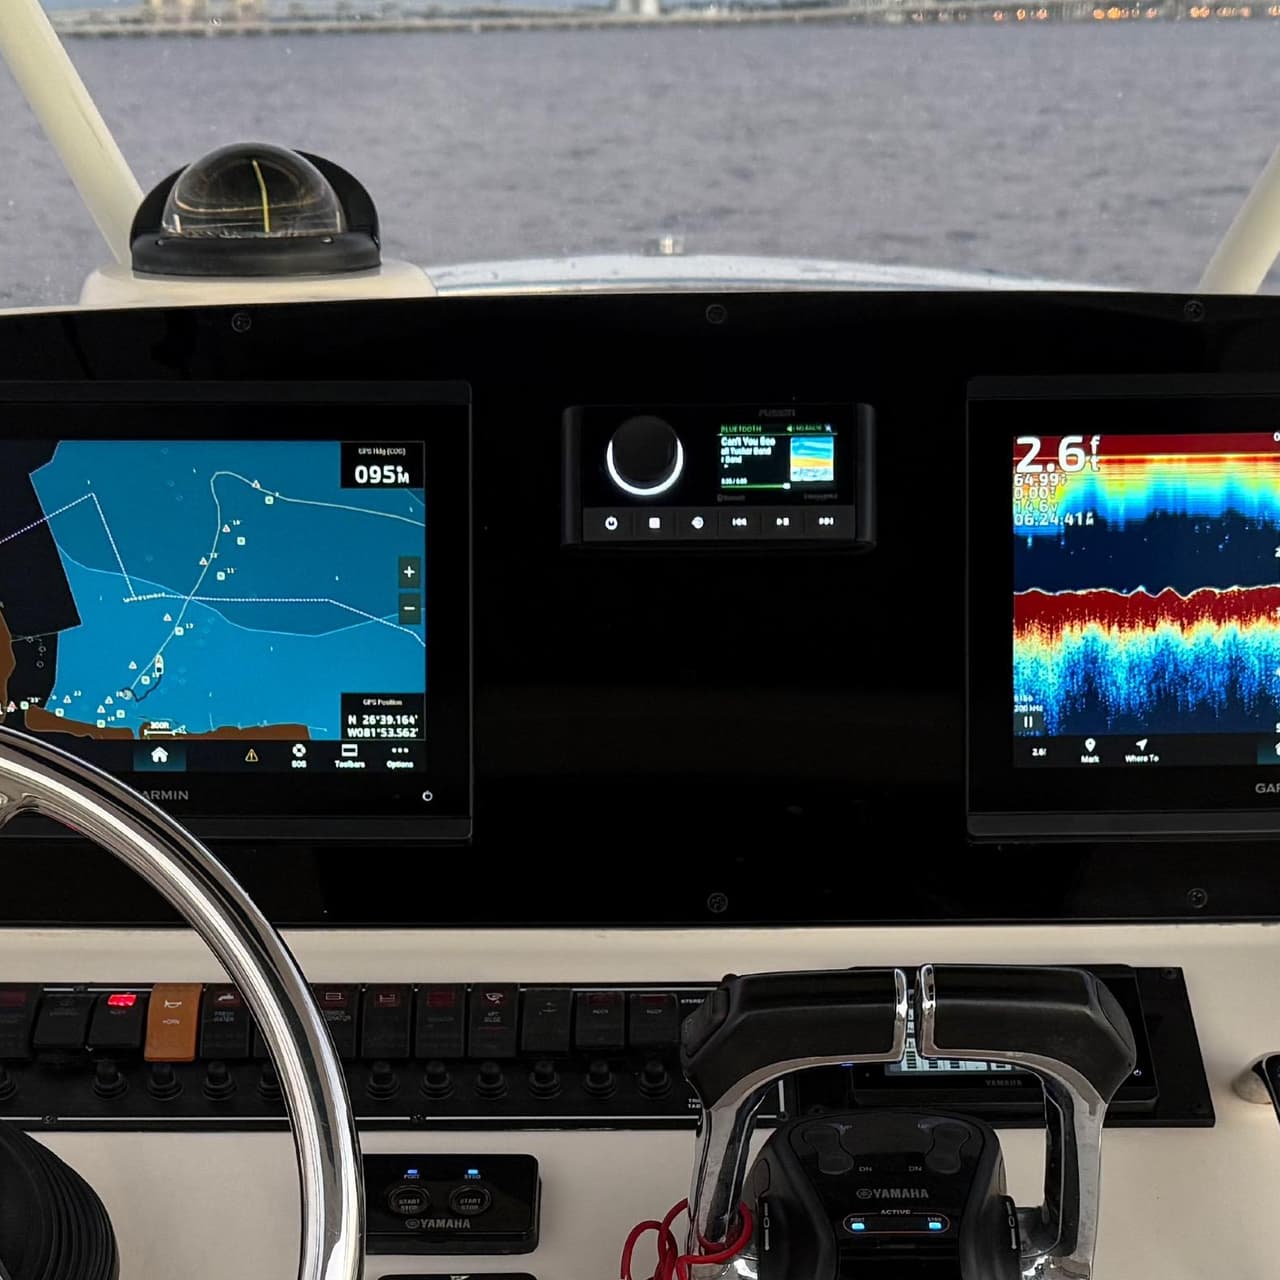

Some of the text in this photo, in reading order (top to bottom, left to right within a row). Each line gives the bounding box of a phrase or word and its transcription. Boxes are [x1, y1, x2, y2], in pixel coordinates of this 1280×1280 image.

[721, 425, 762, 433] BLUETOOTH
[348, 715, 357, 725] N
[1081, 755, 1099, 763] Mark
[1125, 754, 1160, 762] Where To
[334, 760, 366, 768] Toolbars
[386, 760, 414, 770] Options
[142, 789, 189, 801] ARMIN
[873, 1188, 929, 1199] YAMAHA
[421, 1219, 471, 1229] YAMAHA
